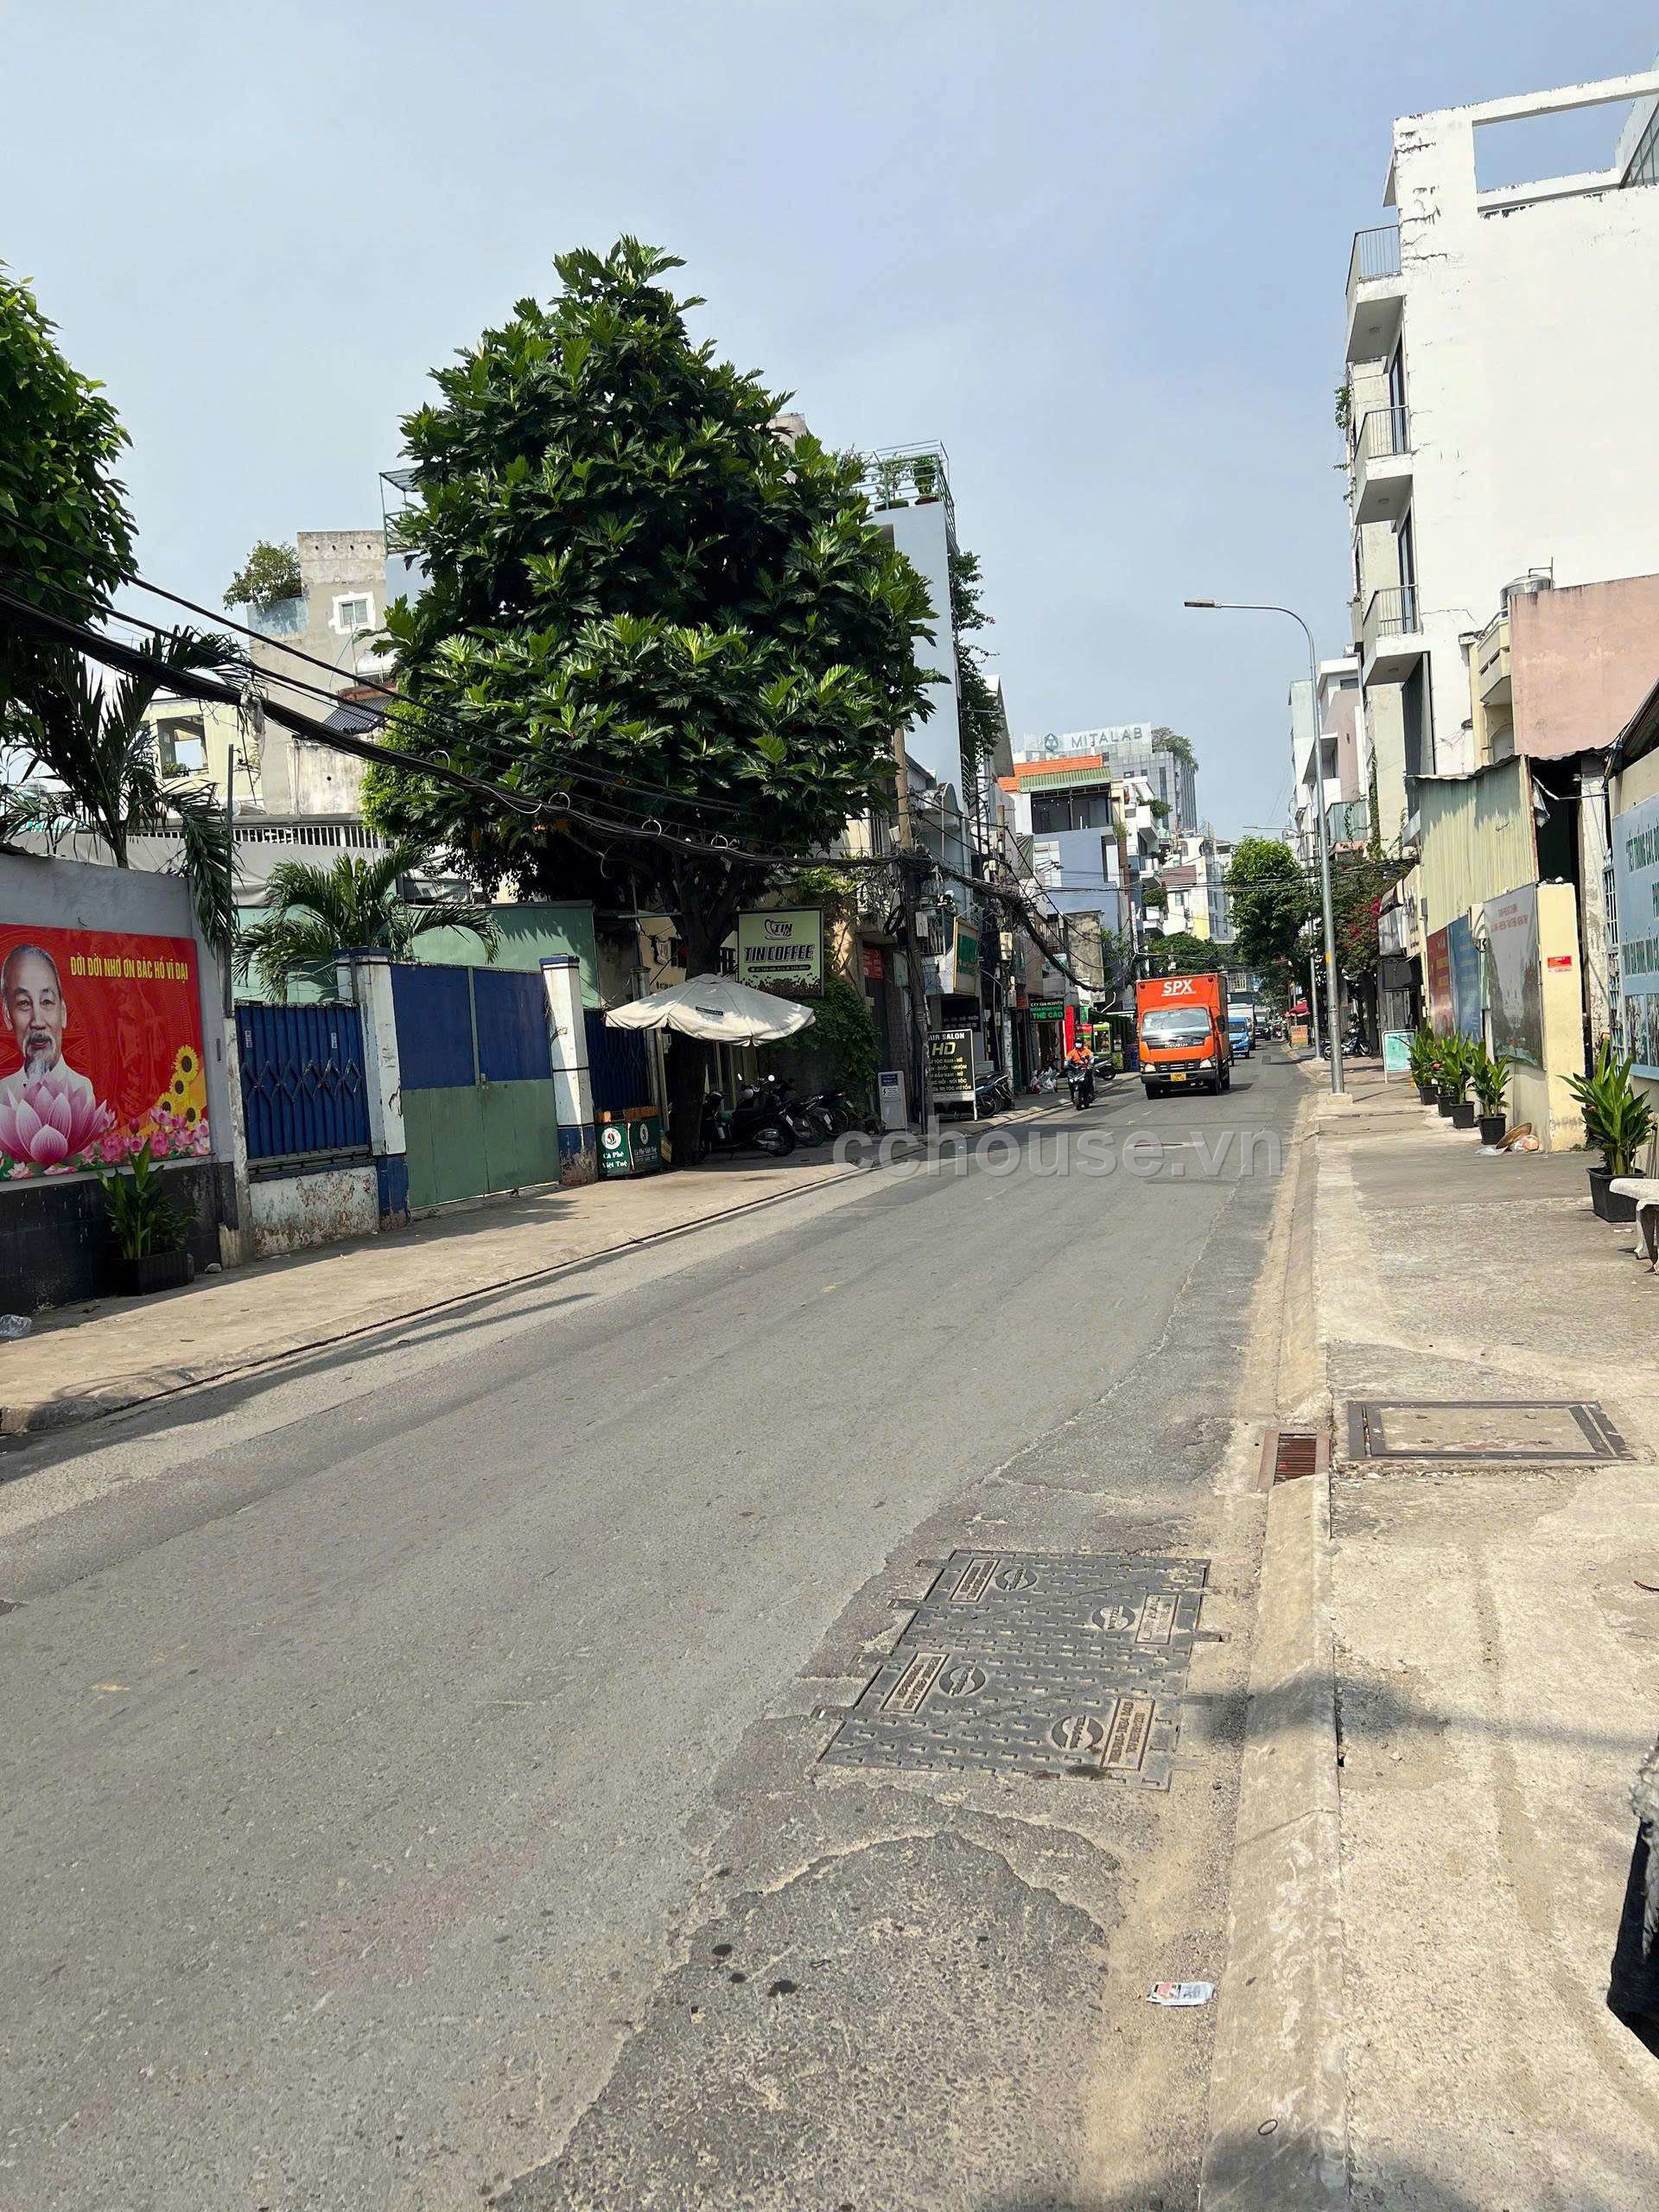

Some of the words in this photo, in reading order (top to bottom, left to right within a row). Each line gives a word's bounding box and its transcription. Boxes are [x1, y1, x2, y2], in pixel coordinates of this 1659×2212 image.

[1071, 727, 1142, 748] MITALAB
[744, 946, 766, 963] TIN
[766, 944, 815, 962] COFFEE
[1163, 979, 1193, 994] SPX
[942, 1032, 965, 1040] SALON
[931, 1041, 957, 1056] HD
